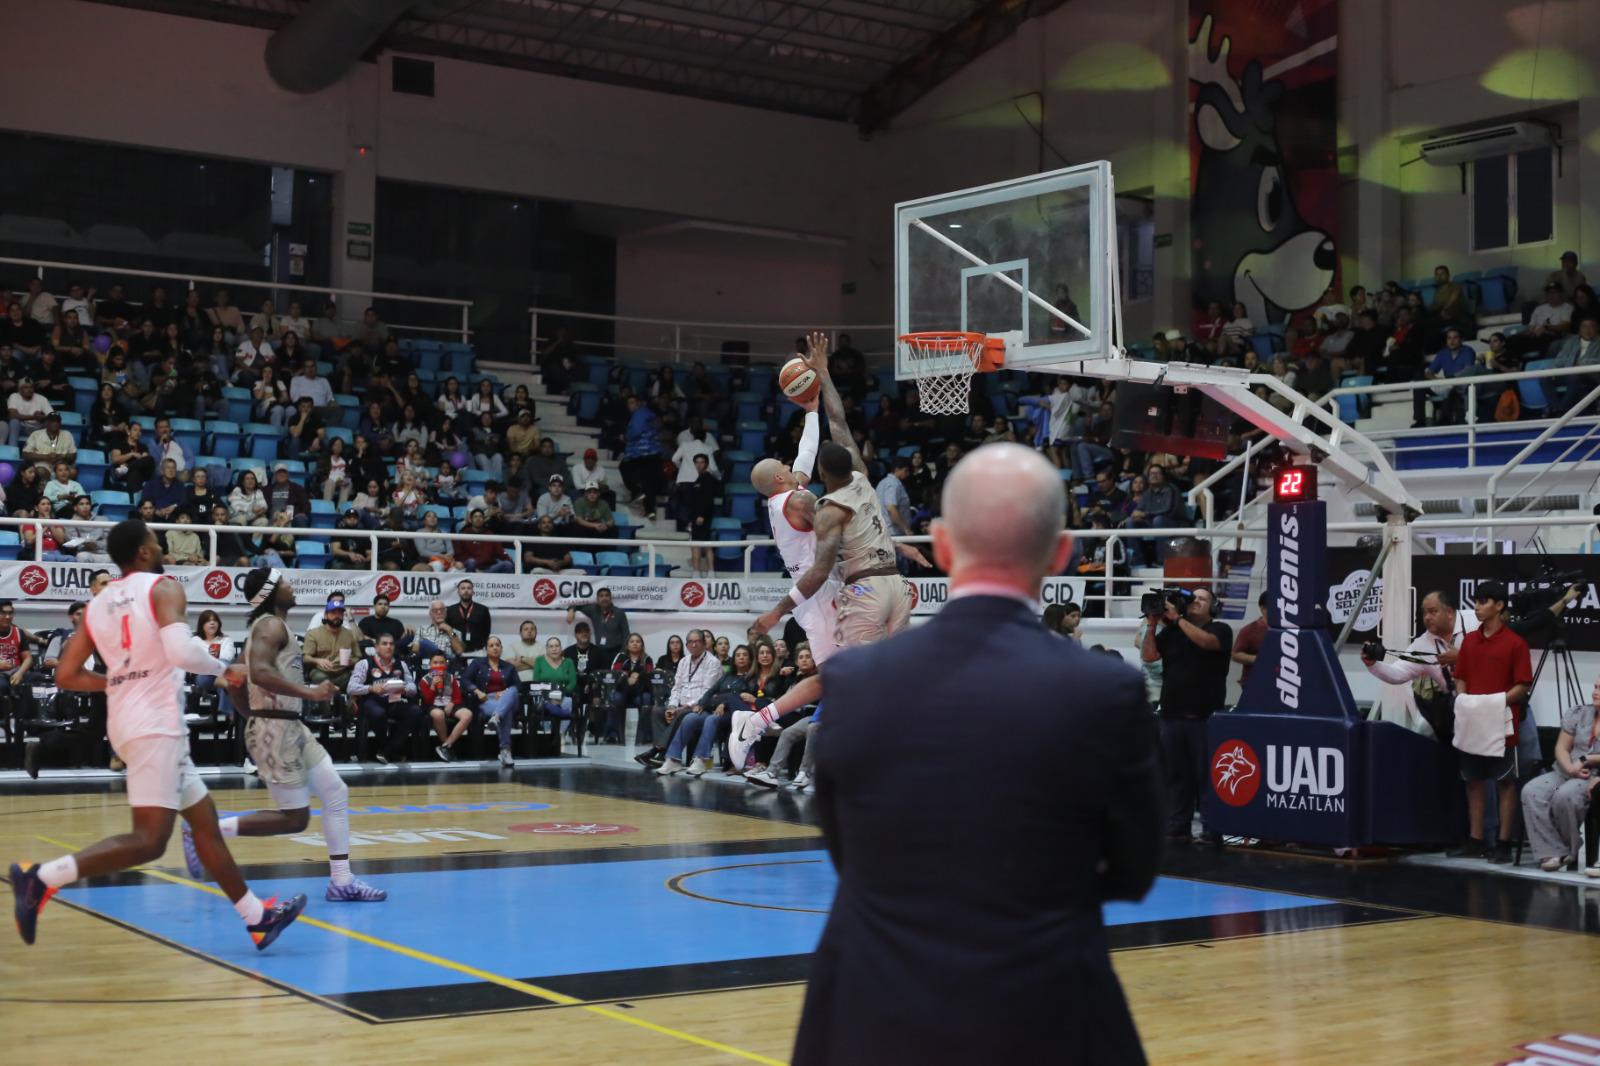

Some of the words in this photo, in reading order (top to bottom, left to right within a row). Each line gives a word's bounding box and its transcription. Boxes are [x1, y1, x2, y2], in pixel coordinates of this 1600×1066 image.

[1281, 473, 1302, 493] 22
[51, 567, 94, 588] UAD
[403, 576, 441, 596] UAD
[559, 580, 594, 598] CID
[707, 583, 741, 601] UAD
[920, 582, 948, 603] UAD
[1042, 583, 1074, 604] CID
[1276, 513, 1301, 709] dportenis
[1266, 744, 1345, 796] UAD
